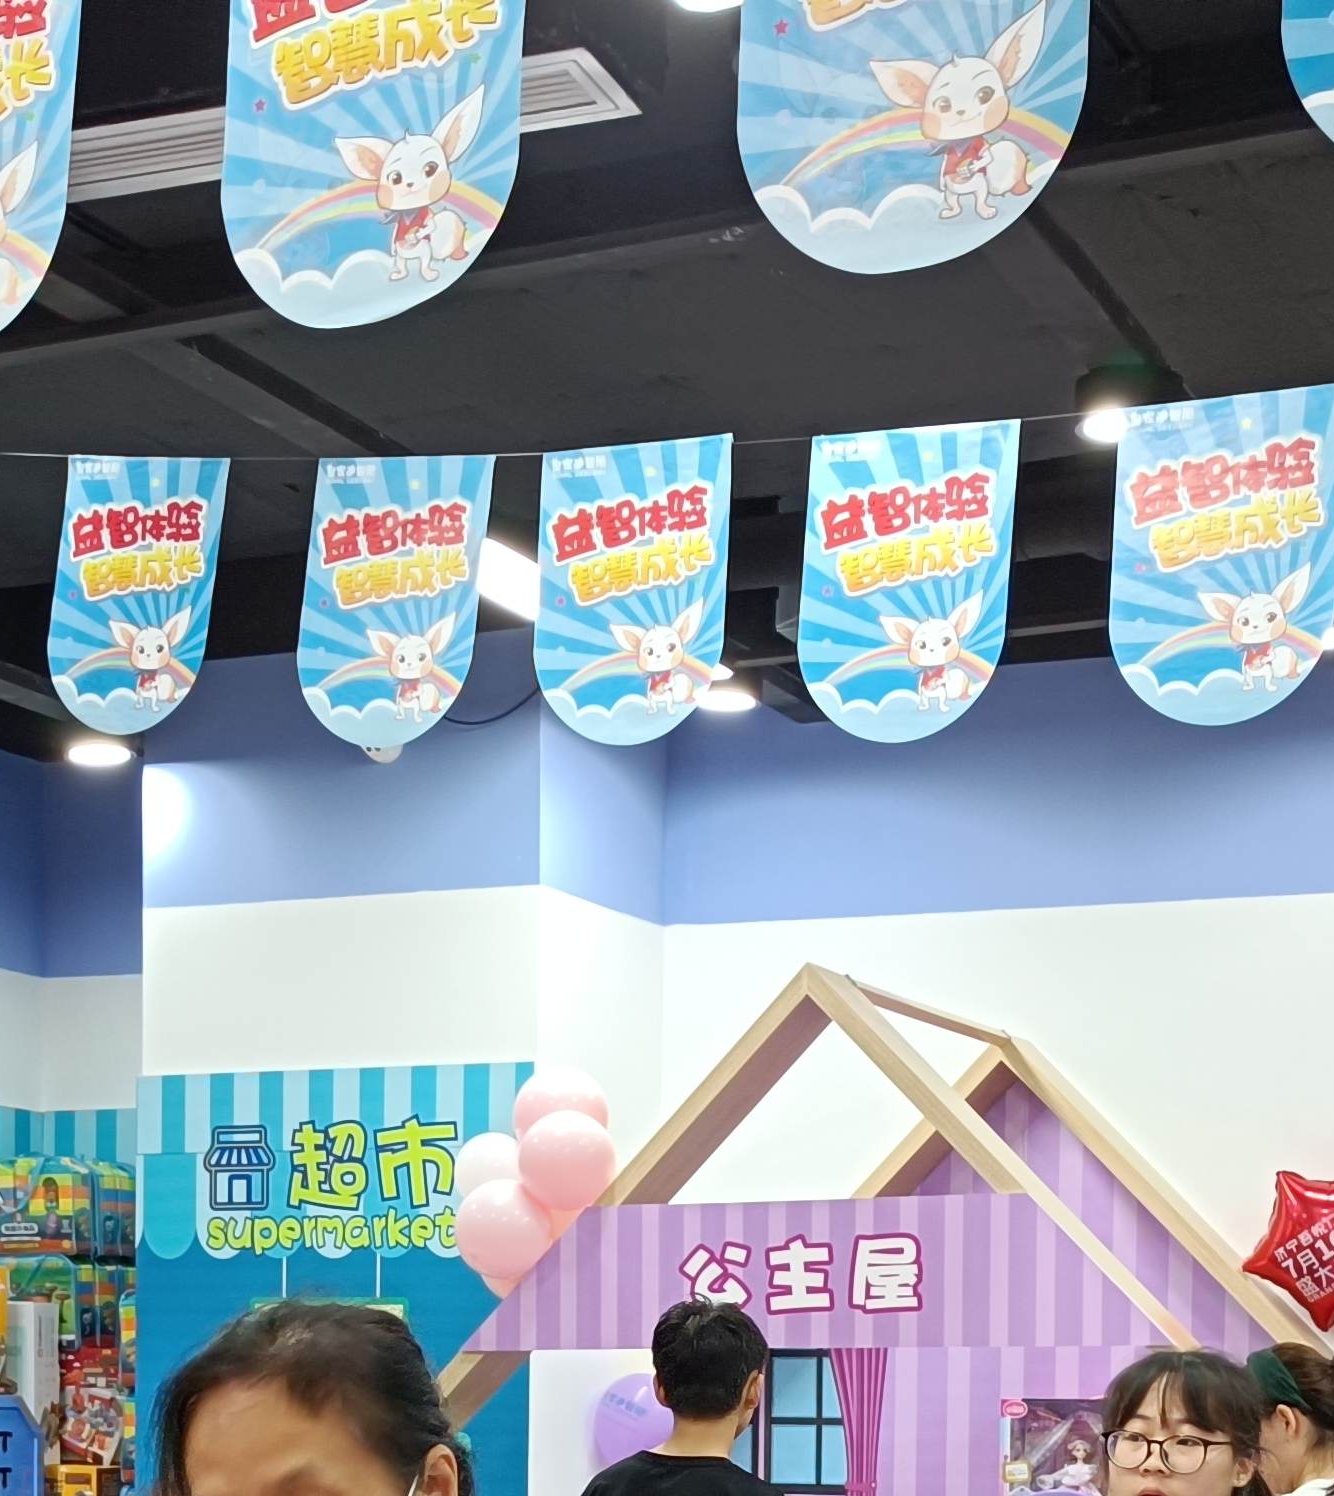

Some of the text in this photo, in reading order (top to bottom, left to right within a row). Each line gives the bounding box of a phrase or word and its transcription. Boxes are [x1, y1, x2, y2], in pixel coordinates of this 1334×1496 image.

[822, 474, 990, 550] 益智体验
[1130, 439, 1316, 524] 益智体验
[72, 501, 203, 557] 益智体验
[322, 504, 466, 564] 益智体验
[553, 486, 708, 561] 益智体验
[1152, 489, 1320, 563] 智慧成长
[82, 545, 201, 597] 智慧成长
[336, 551, 466, 606] 智慧成长
[570, 535, 712, 602] 智慧成长
[840, 524, 994, 592] 智慧成长
[288, 1114, 458, 1209] 超市
[205, 1206, 457, 1255] supermarket
[679, 1233, 924, 1315] 公主屋
